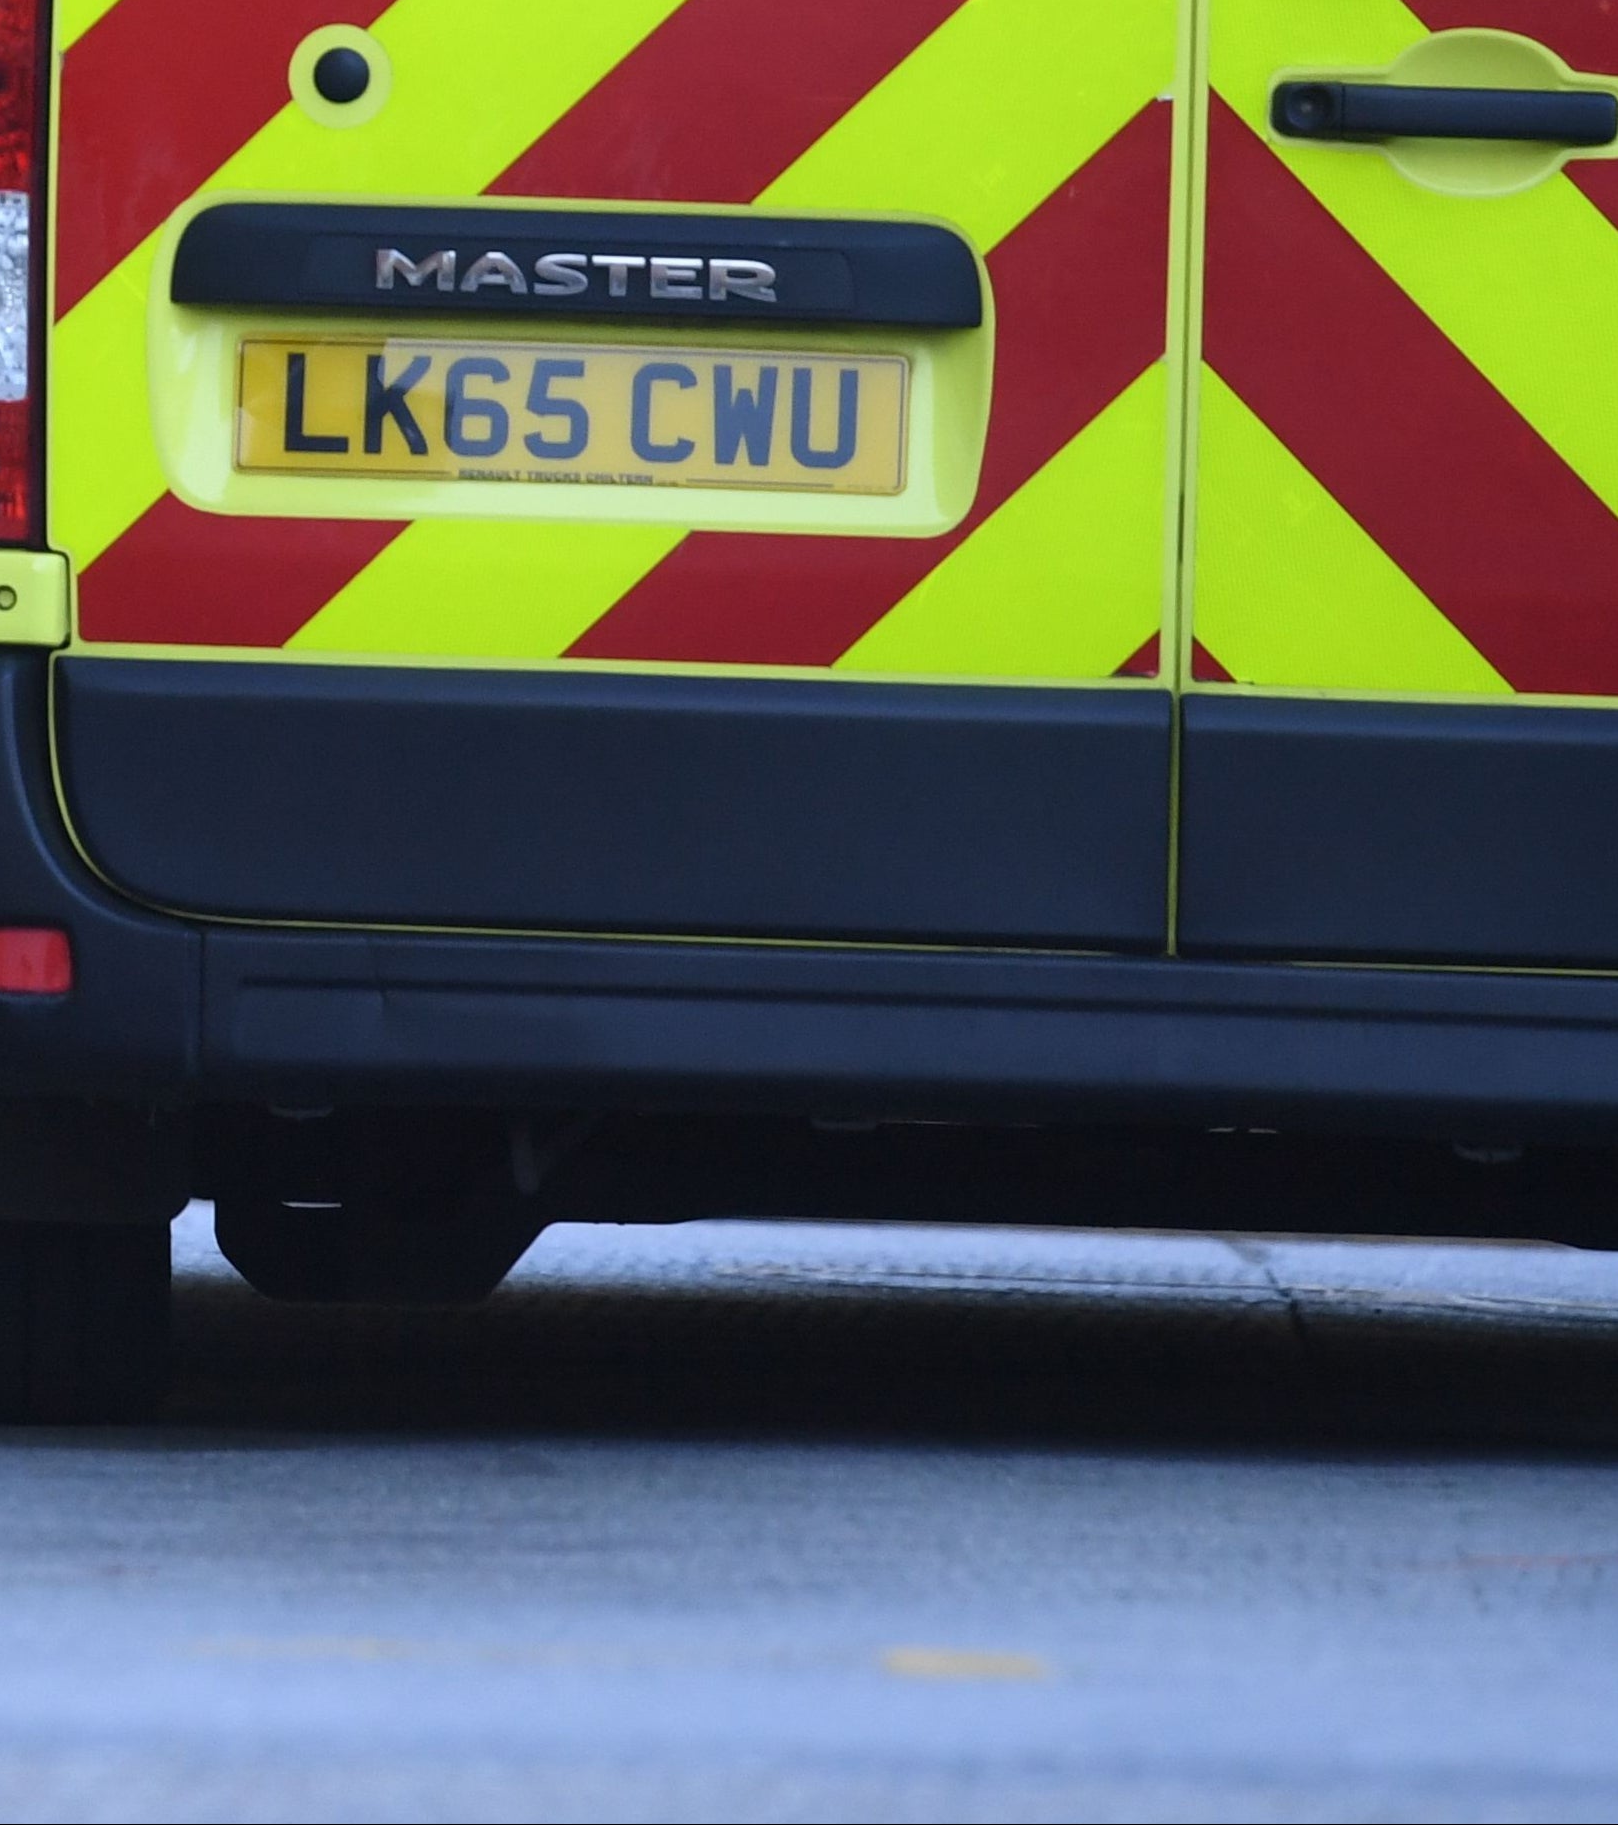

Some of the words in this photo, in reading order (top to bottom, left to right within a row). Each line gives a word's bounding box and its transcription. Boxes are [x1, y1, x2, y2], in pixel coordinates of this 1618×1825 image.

[375, 247, 778, 303] MASTER
[283, 351, 590, 461] LK65
[631, 361, 860, 471] CWU
[458, 470, 520, 482] RENAULT
